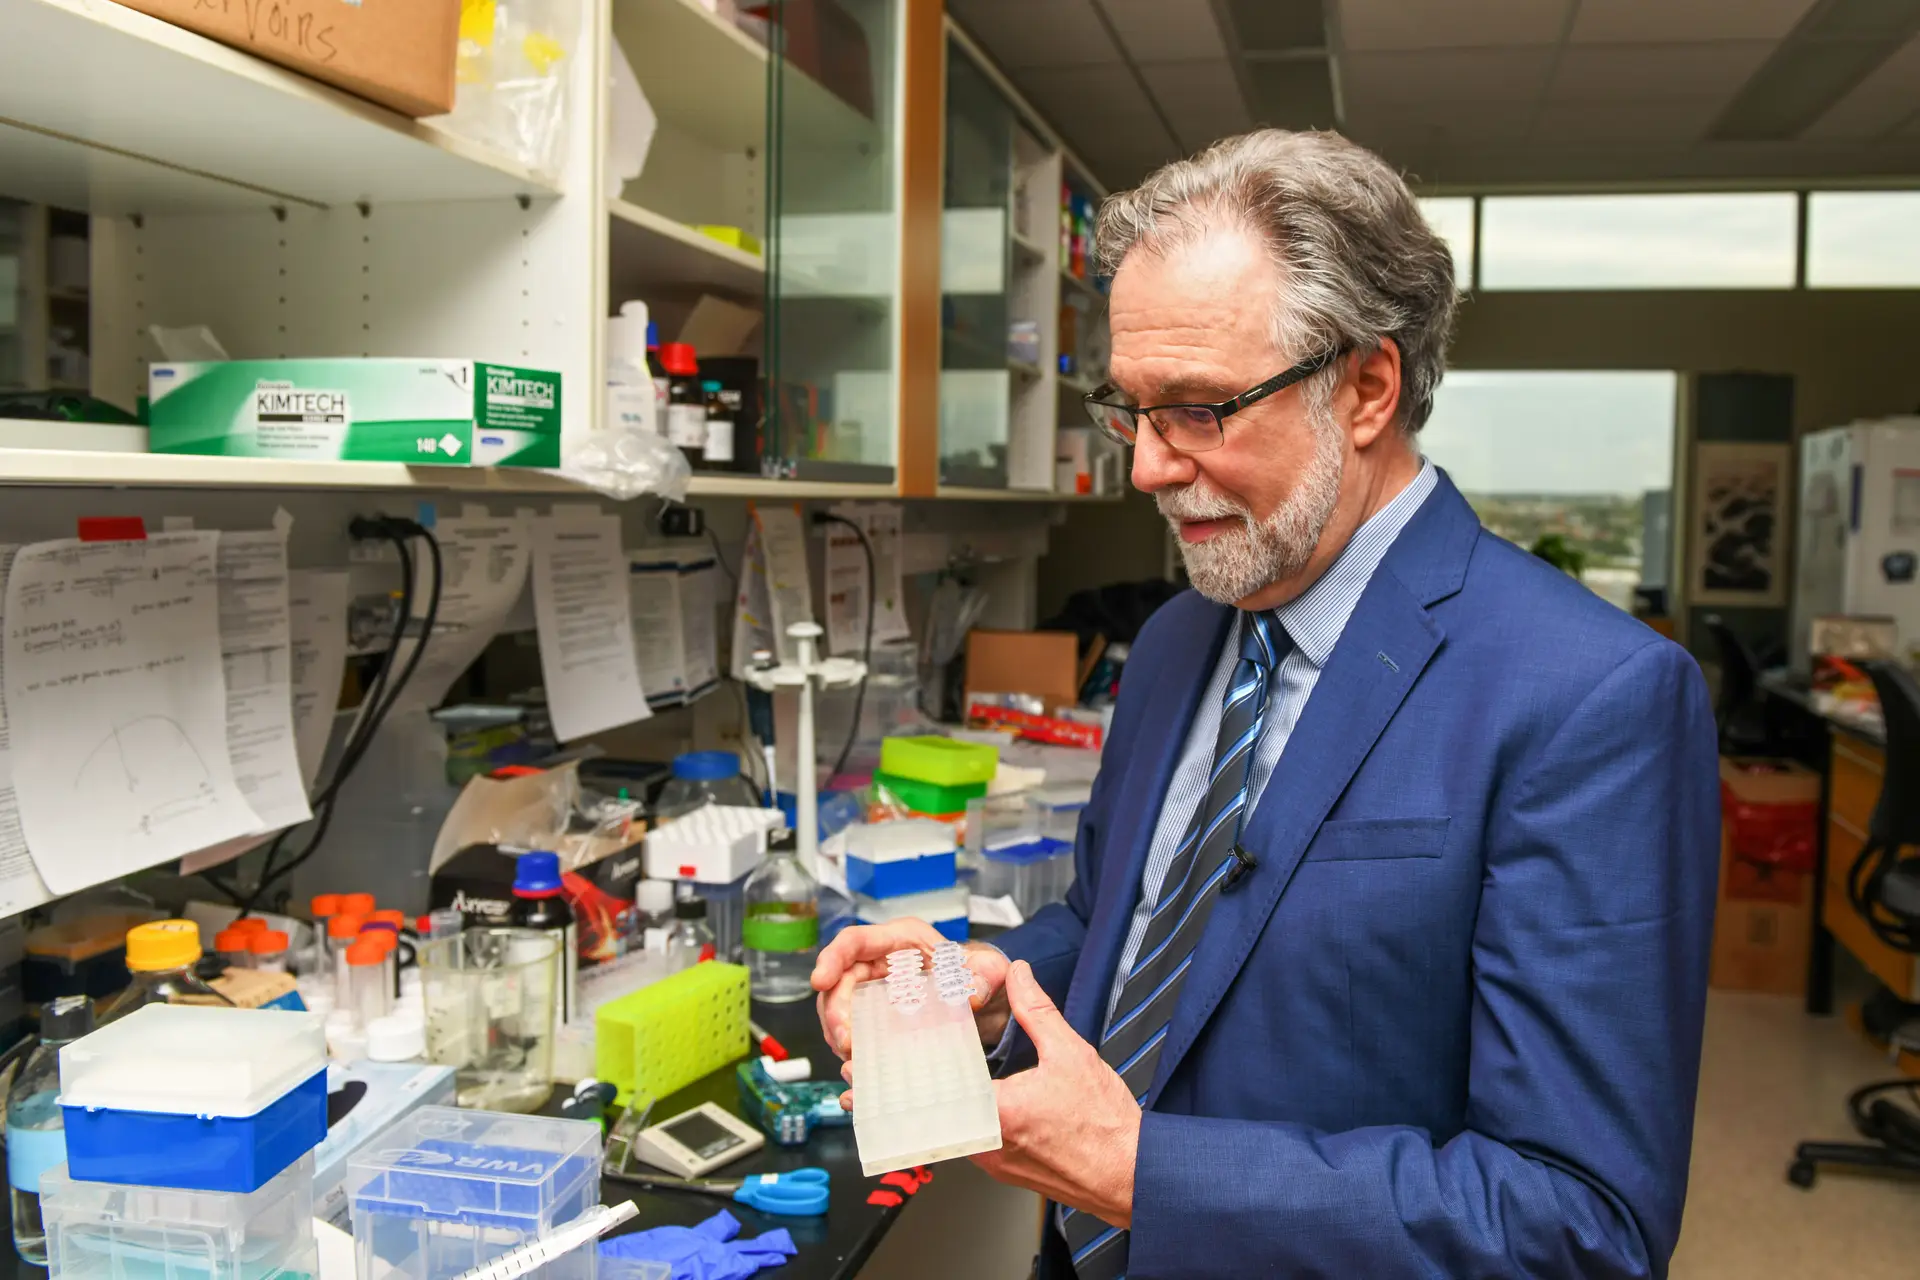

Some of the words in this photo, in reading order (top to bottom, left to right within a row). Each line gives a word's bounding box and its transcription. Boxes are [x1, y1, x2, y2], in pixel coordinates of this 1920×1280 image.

[486, 376, 555, 400] KIMTECH
[257, 393, 344, 412] KIMTECH
[454, 1156, 544, 1175] VWR
